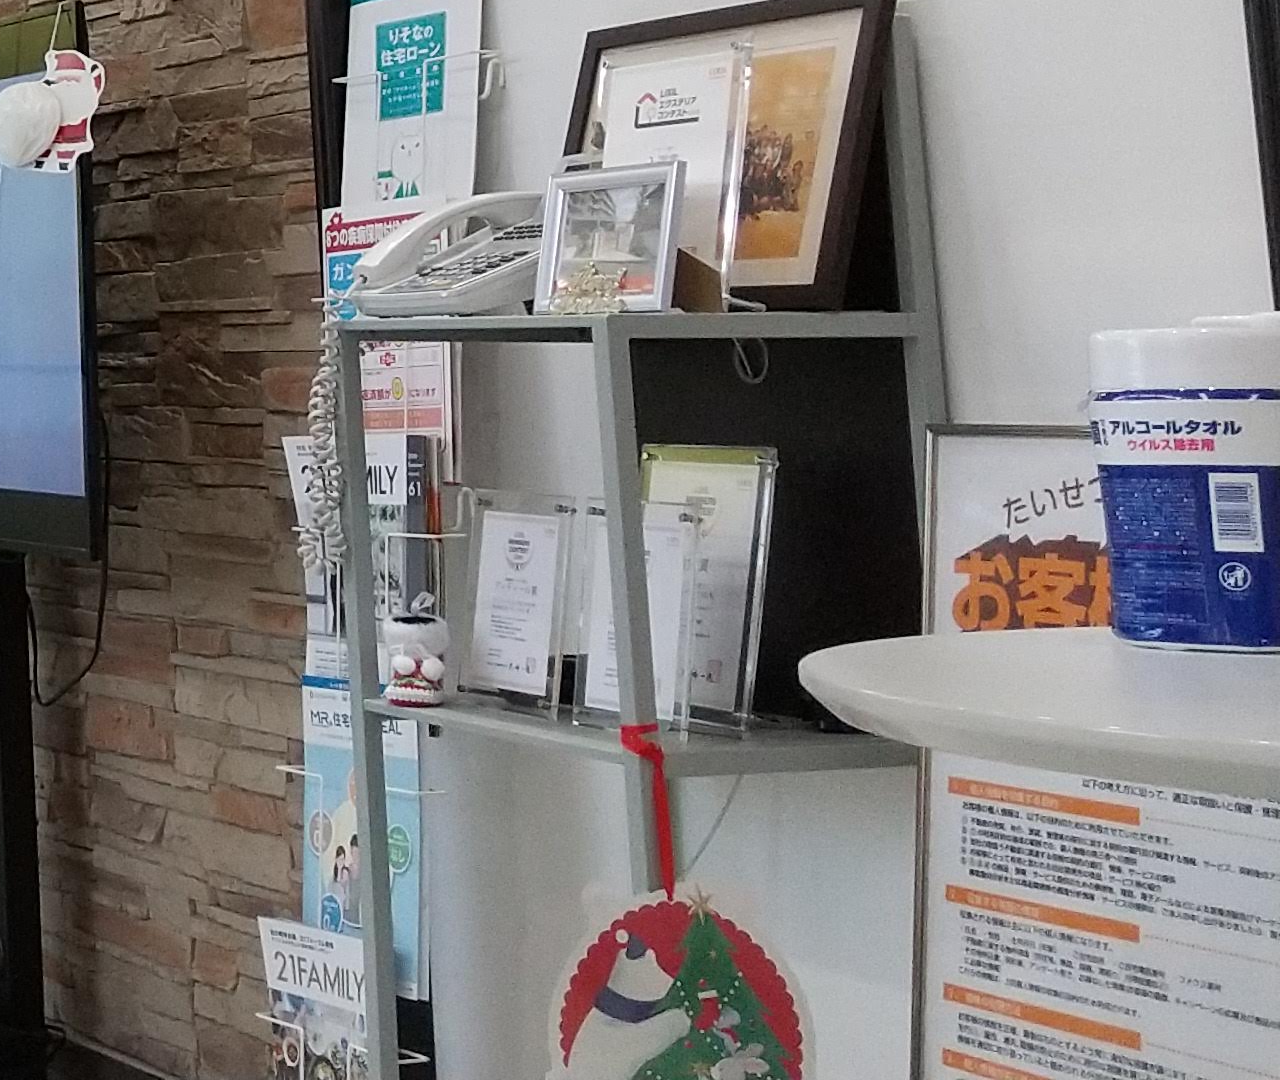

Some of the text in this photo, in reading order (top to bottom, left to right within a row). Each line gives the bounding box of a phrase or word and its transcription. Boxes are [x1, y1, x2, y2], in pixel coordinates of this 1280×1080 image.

[388, 25, 434, 45] りそなの
[381, 41, 441, 67] 住宅ローン
[1108, 419, 1242, 437] アルコールタオル
[408, 481, 421, 497] 61
[274, 950, 365, 1003] 21FAMILY
